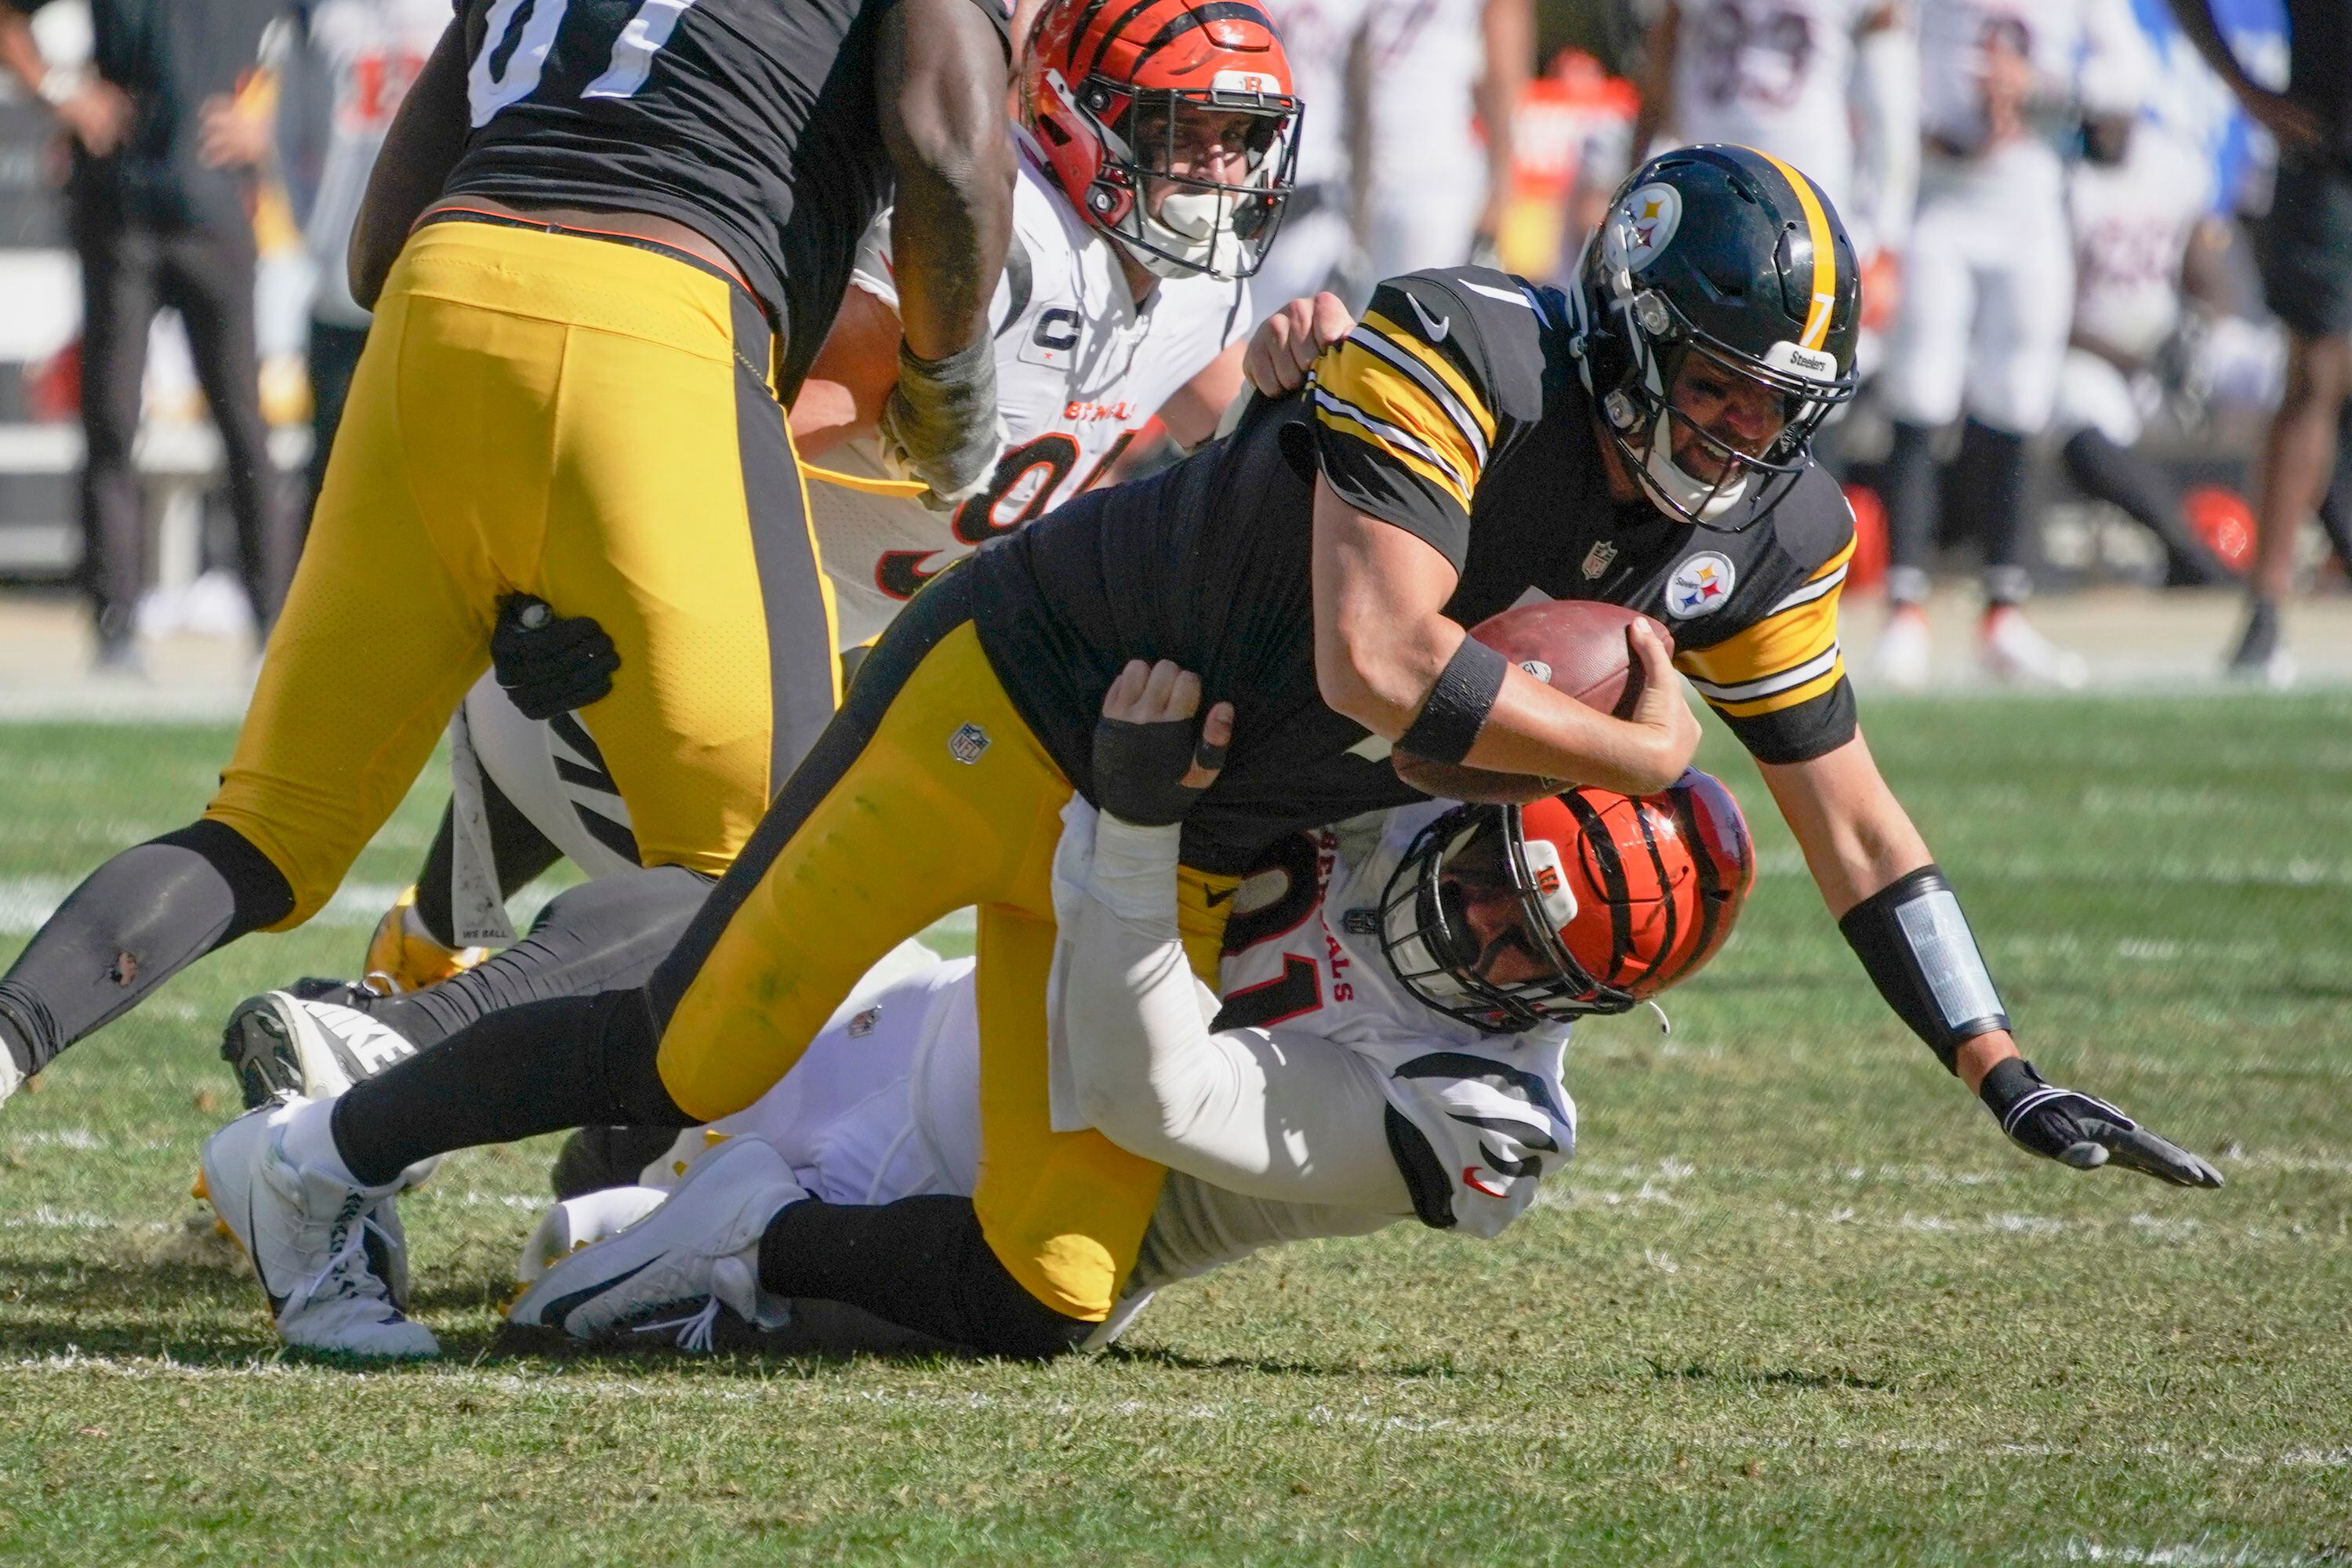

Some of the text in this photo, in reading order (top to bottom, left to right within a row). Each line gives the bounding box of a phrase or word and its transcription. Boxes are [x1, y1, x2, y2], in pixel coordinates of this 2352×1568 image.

[1033, 308, 1079, 351] C
[1799, 292, 1835, 347] 7
[1791, 350, 1827, 372] Steelers
[953, 735, 979, 759] NFL
[463, 929, 478, 938] WE
